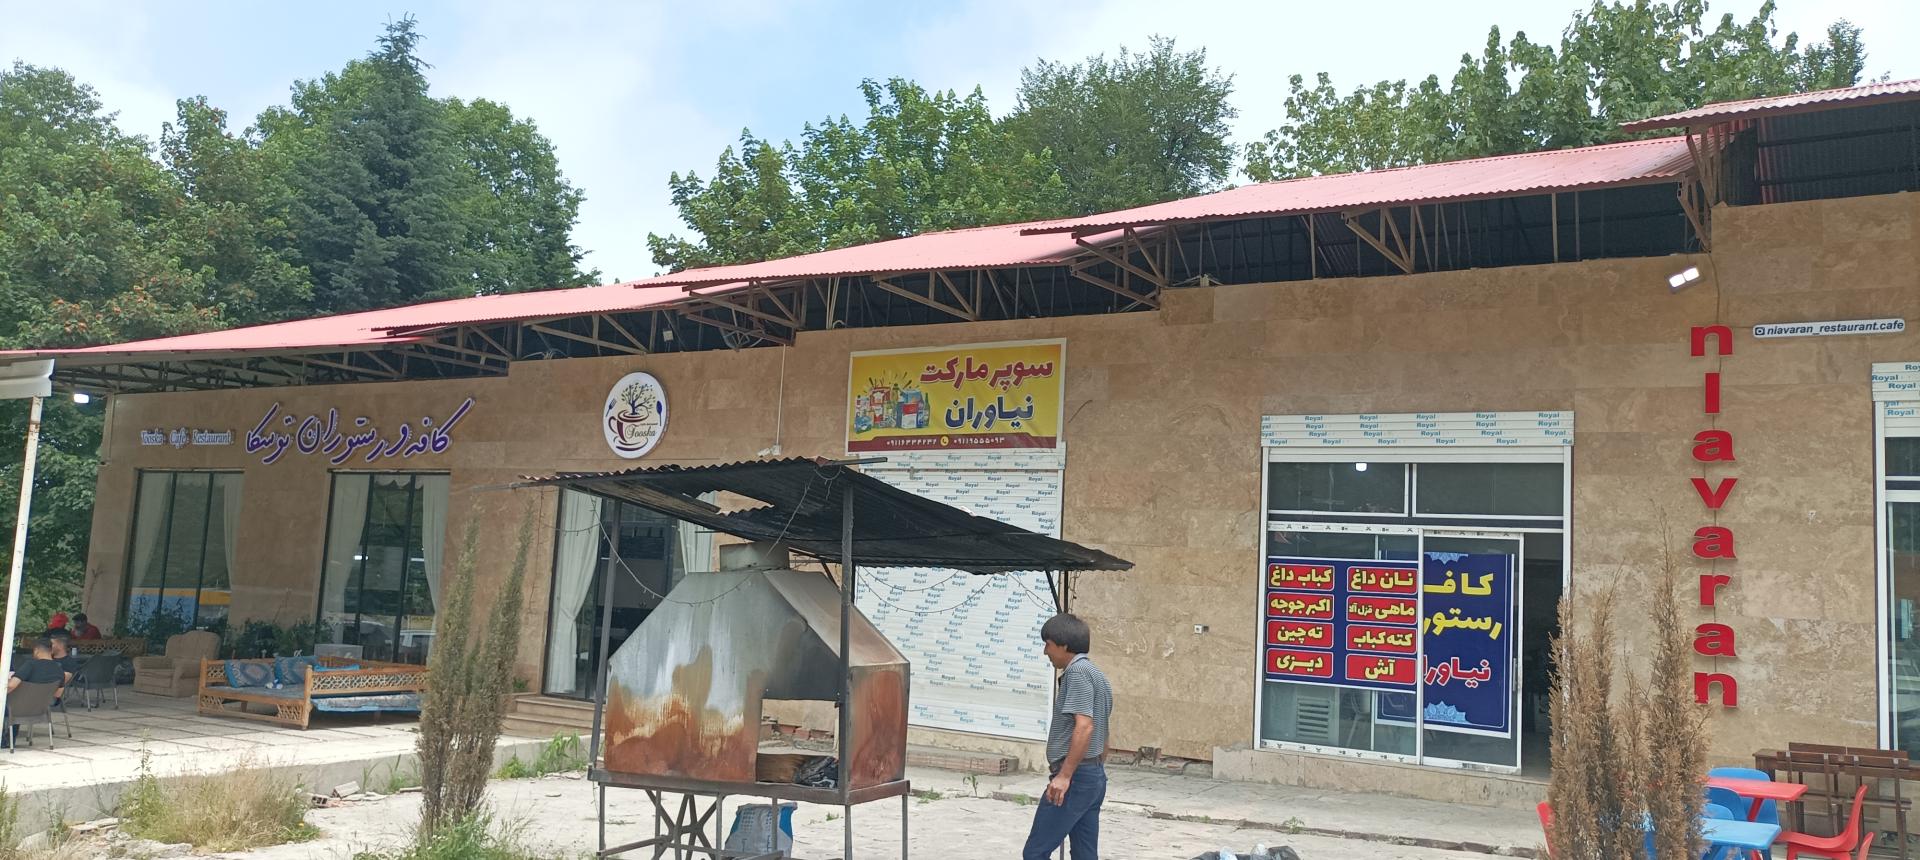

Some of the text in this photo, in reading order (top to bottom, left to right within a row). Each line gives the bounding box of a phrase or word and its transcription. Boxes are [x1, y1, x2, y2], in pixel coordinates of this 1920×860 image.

[1766, 320, 1904, 336] niavaran_restaurant.cafe
[919, 356, 1054, 391] سوپر مارکت
[1872, 374, 1899, 383] Royal
[1888, 382, 1917, 391] Royal
[945, 395, 1034, 430] نیاوران
[1416, 413, 1436, 421] Royal
[1476, 412, 1497, 420] Royal
[1538, 412, 1560, 420] Royal
[1887, 409, 1915, 418] Royal
[246, 402, 296, 464] توسکا
[403, 398, 476, 457] کافه
[1537, 420, 1560, 428] Royal
[1544, 429, 1566, 437] Royal
[1270, 565, 1332, 587] کباب داغ
[1350, 568, 1414, 591] نان داغ
[1423, 570, 1494, 596] کاف
[1270, 598, 1331, 616] اکبر جوجه
[1374, 602, 1416, 620] ماهی
[1277, 626, 1323, 645] ته چین
[1353, 630, 1413, 649] کته کباب
[1276, 654, 1324, 672] دیزی
[1364, 659, 1396, 680] آش
